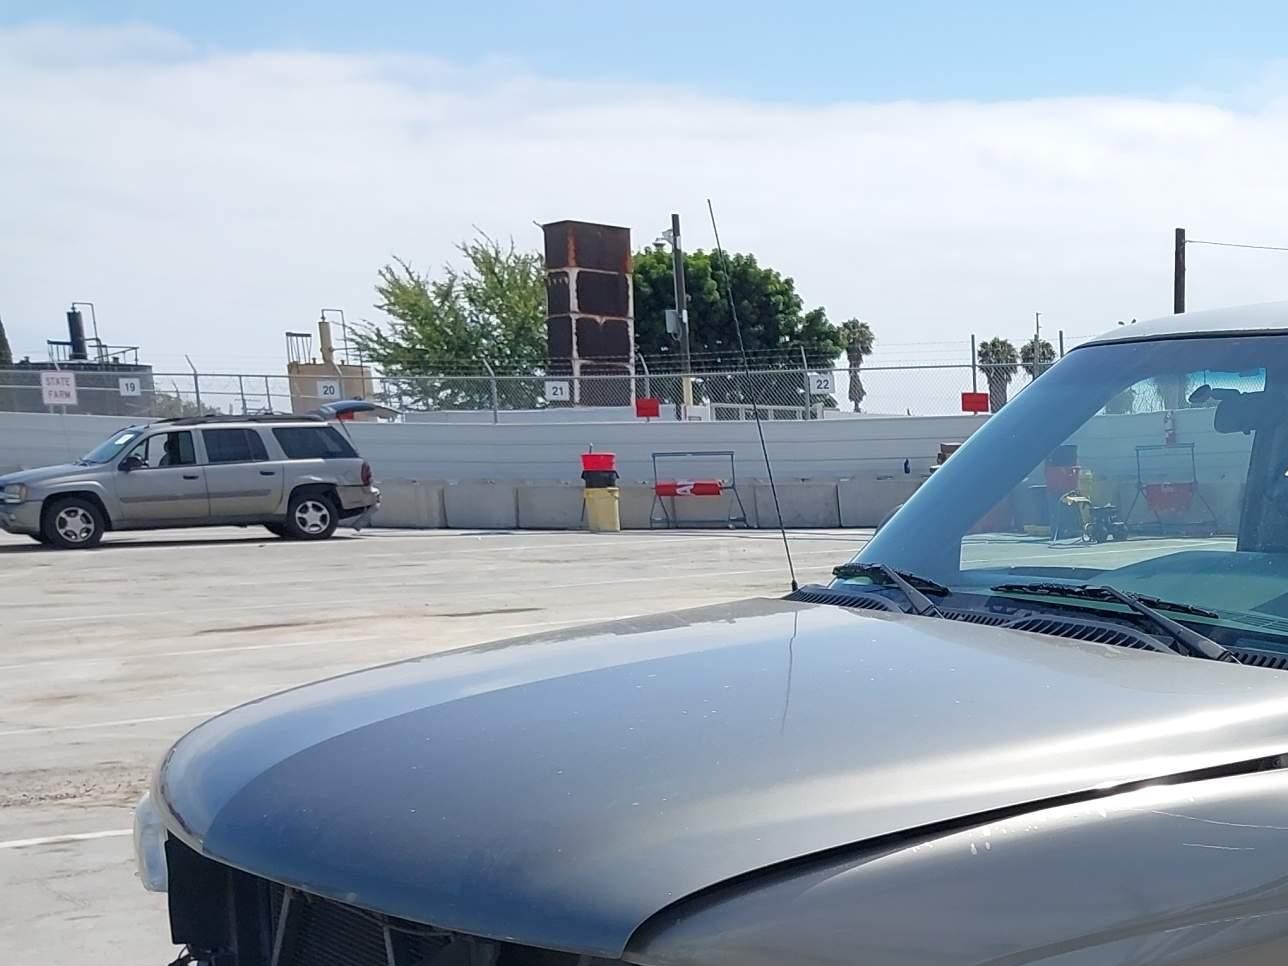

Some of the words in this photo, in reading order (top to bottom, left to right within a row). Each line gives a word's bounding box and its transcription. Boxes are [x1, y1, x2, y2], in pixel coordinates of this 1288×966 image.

[45, 377, 71, 386] STATE
[816, 378, 830, 389] 22
[124, 382, 136, 392] 19
[322, 385, 335, 395] 20
[552, 386, 564, 396] 21
[48, 390, 71, 399] FARM
